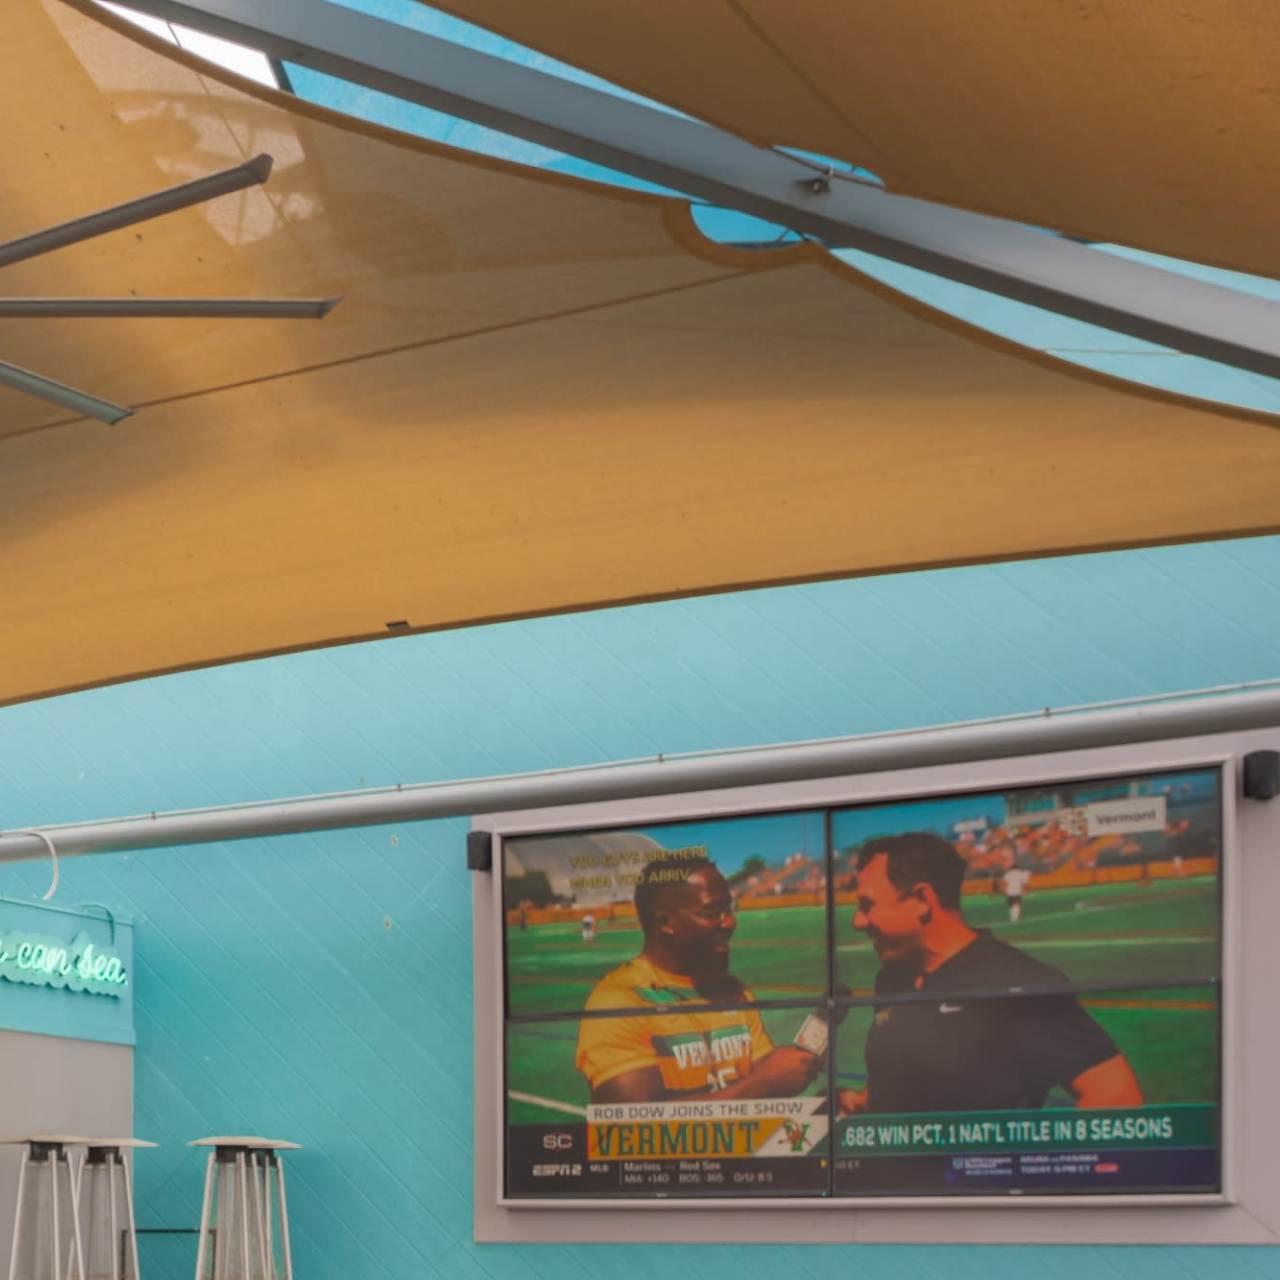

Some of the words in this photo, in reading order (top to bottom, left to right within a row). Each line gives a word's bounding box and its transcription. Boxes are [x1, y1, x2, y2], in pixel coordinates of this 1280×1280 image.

[1096, 810, 1156, 824] Vermont
[17, 941, 71, 976] can
[594, 1108, 624, 1121] ROB
[628, 1107, 665, 1119] DOW
[670, 1106, 714, 1119] JOINS
[721, 1104, 749, 1117] THE
[754, 1102, 803, 1116] SHOW
[543, 1134, 573, 1150] SC
[595, 1120, 760, 1157] VERMONT
[878, 1125, 910, 1145] WIN
[948, 1123, 957, 1143] 1
[958, 1121, 1005, 1143] NAT'L
[1006, 1120, 1051, 1142] TITLE
[1054, 1120, 1072, 1140] IN
[1075, 1119, 1087, 1140] 8
[1089, 1116, 1173, 1140] SEASONS
